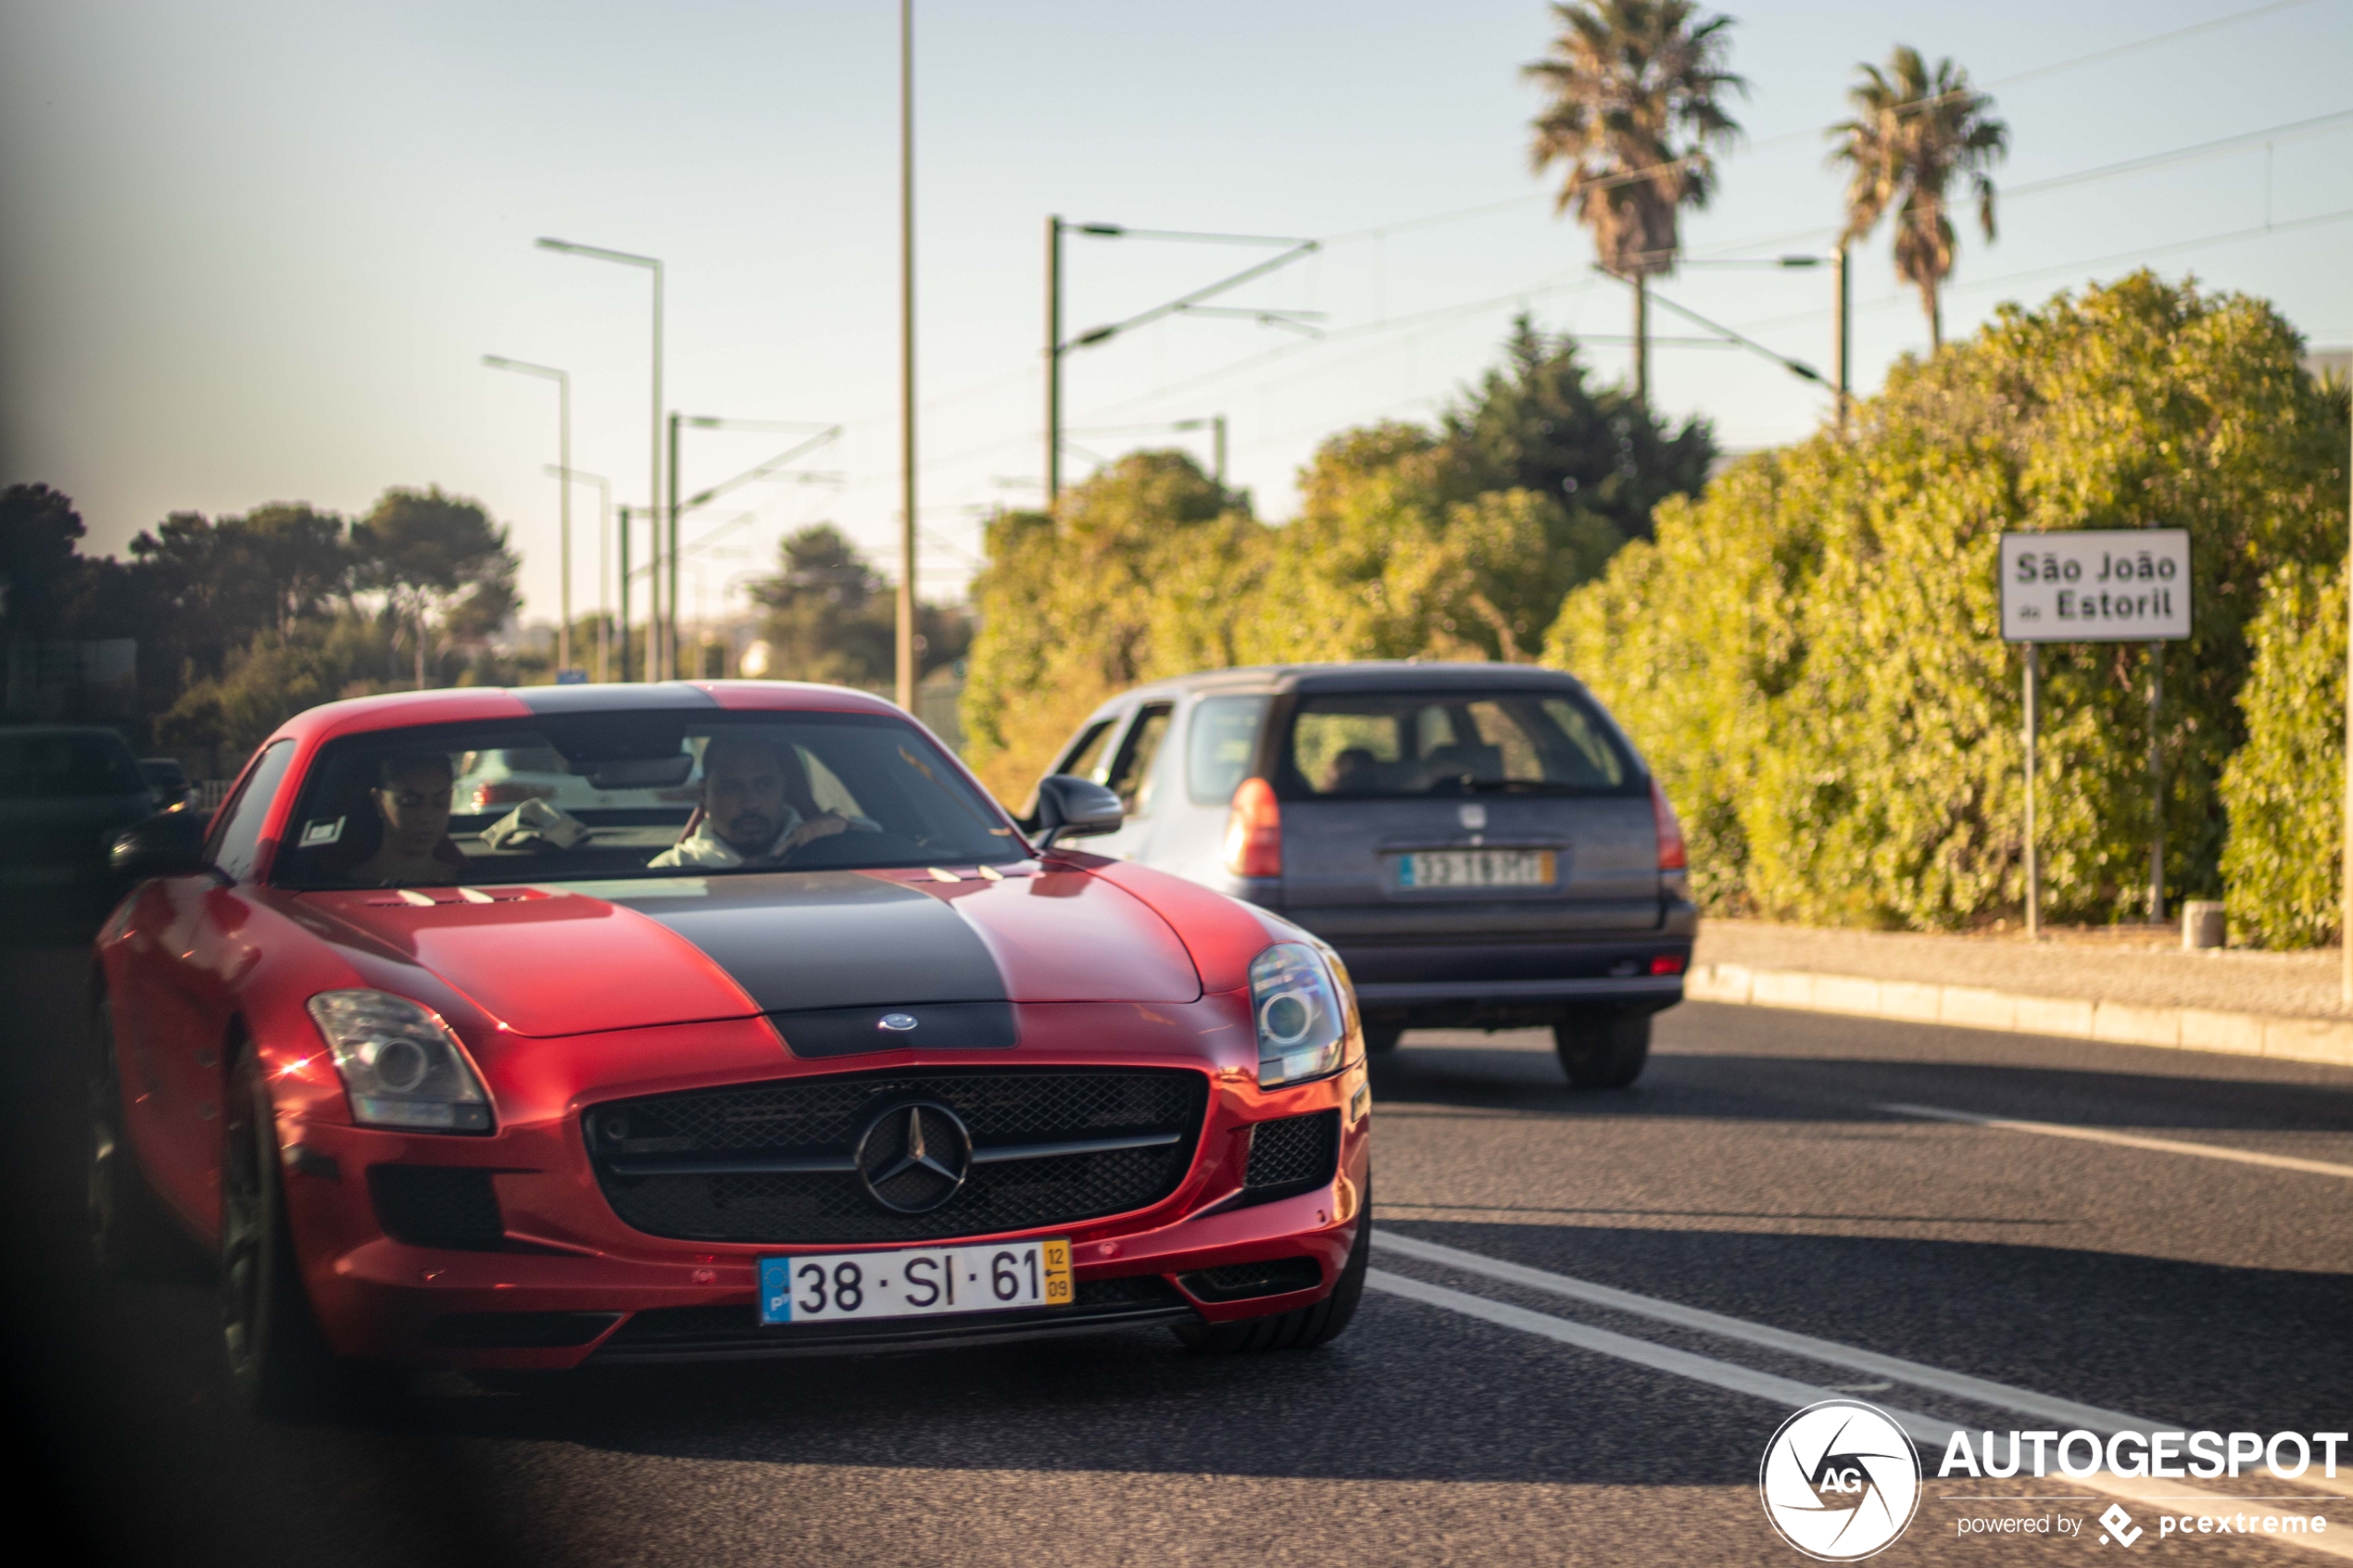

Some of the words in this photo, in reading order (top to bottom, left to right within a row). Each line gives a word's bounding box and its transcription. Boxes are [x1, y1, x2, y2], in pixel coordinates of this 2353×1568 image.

[2017, 552, 2082, 583] São
[2097, 550, 2176, 583] João
[2057, 587, 2172, 619] Estoril
[1049, 1248, 1064, 1265] 12
[1049, 1281, 1067, 1297] 09
